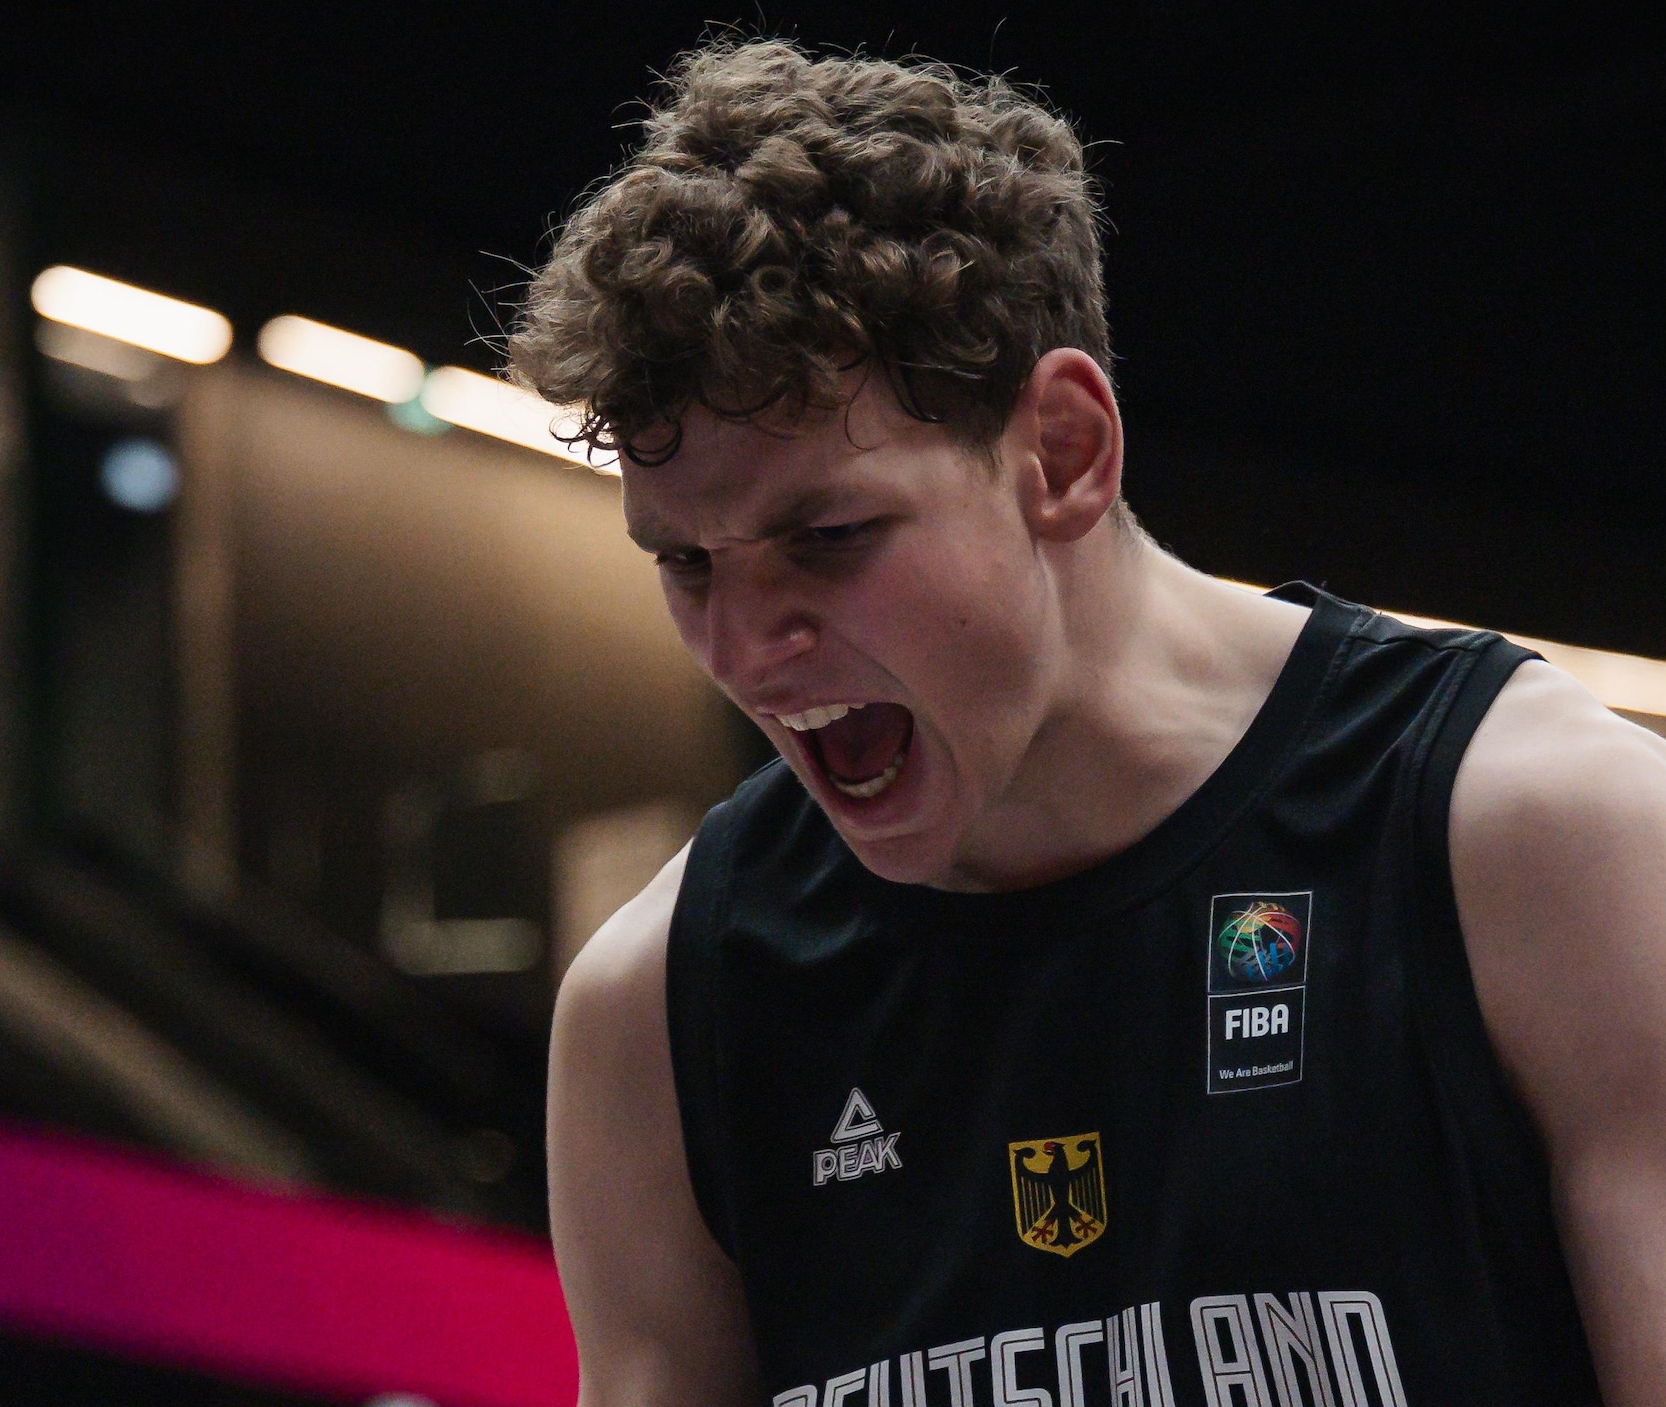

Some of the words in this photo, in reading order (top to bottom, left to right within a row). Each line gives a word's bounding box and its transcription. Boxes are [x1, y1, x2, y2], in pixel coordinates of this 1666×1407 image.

[1225, 1003, 1289, 1040] FIBA
[1219, 1069, 1235, 1080] We
[1236, 1067, 1251, 1078] Are
[1252, 1060, 1293, 1076] Basketball
[813, 1132, 903, 1186] PEAK
